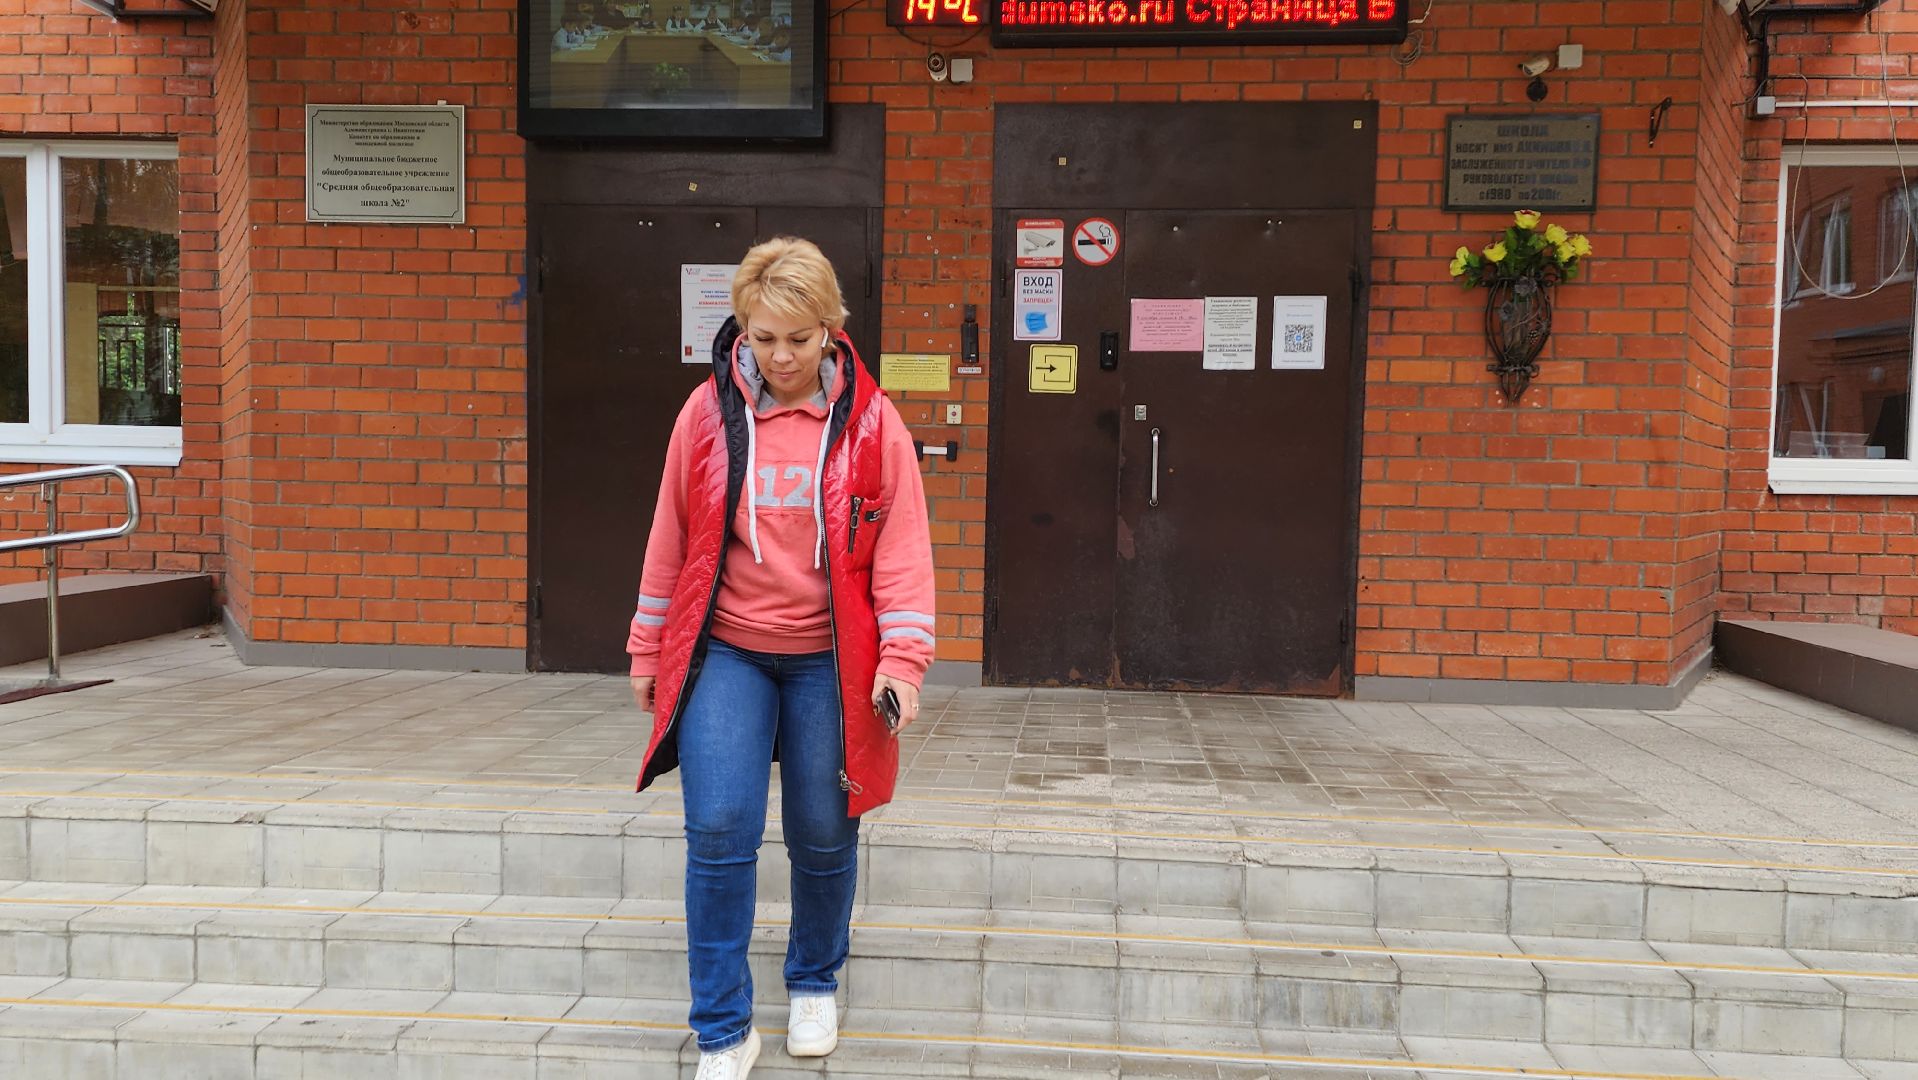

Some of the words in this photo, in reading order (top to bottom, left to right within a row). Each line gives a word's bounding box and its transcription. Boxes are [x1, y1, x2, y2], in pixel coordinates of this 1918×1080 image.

[1186, 0, 1359, 29] Страница
[1498, 125, 1548, 137] ШКОЛА
[1456, 143, 1488, 153] НОСИТ
[1494, 143, 1513, 153] ИМЯ
[333, 154, 395, 163] Муниципальное
[396, 155, 438, 163] бюджетное
[1451, 159, 1524, 170] ЗАСЛУЖЕННОГО
[321, 168, 403, 177] общеобразовательное
[404, 169, 450, 178] учреждение
[317, 182, 359, 192] "Средняя
[360, 183, 455, 193] общеобразовательная
[360, 199, 389, 207] школа
[390, 198, 410, 208] №2"
[1023, 276, 1053, 288] ВХОД
[755, 466, 812, 507] 12
